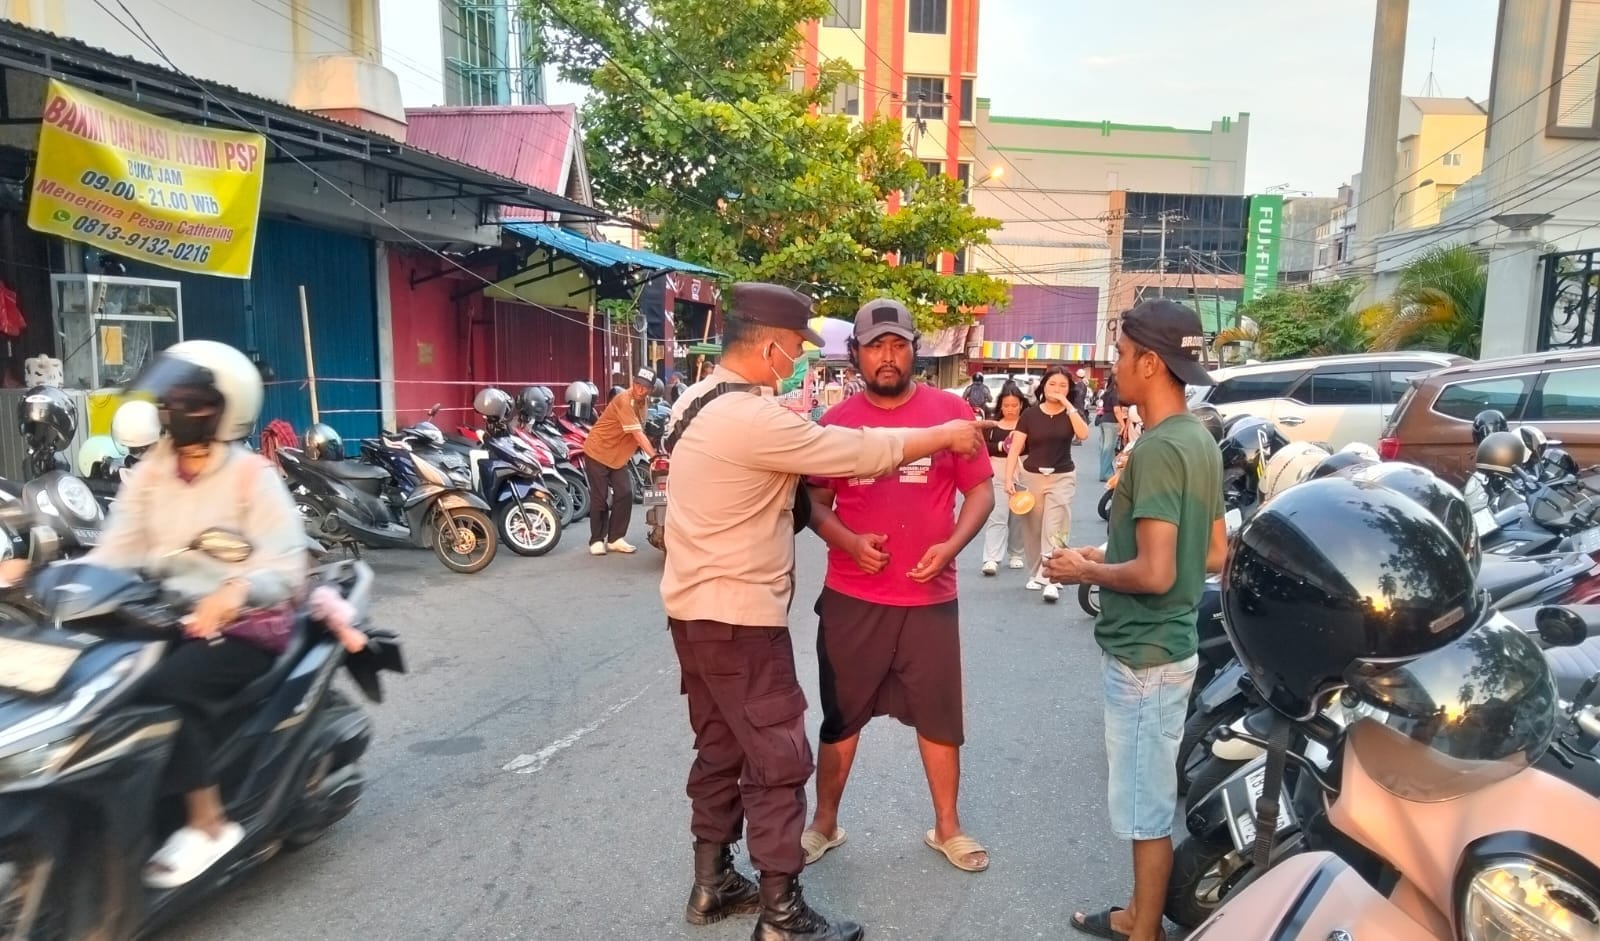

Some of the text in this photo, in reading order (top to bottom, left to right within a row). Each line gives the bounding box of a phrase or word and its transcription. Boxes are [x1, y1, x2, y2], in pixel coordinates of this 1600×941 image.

[43, 96, 258, 172] BAKMI DAN NASI AYAM PSP
[80, 170, 136, 201] 09.00
[149, 190, 189, 211] 21.00
[191, 194, 220, 214] Wib
[127, 159, 183, 186] BUKA JAM
[35, 178, 234, 242] Menerima Pesan Cathering
[72, 215, 210, 264] 0813-9132-0216
